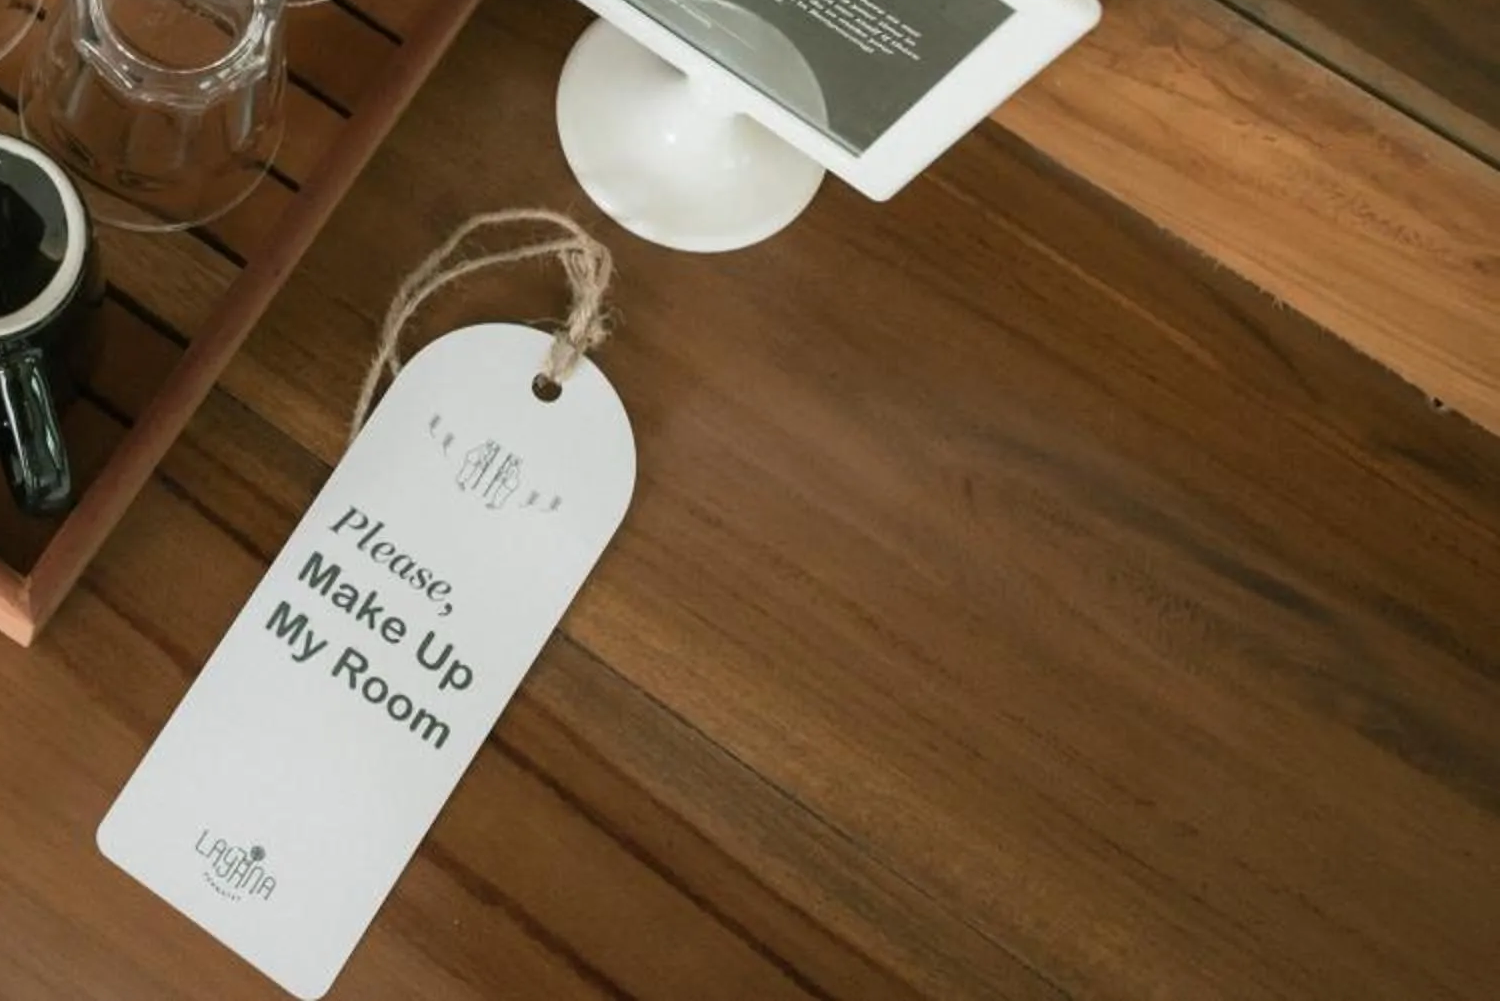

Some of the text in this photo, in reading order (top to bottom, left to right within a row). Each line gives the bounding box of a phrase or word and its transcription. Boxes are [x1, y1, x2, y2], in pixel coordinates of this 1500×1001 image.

[298, 551, 473, 691] Make Up
[330, 505, 452, 617] Please,
[265, 601, 451, 749] My Room
